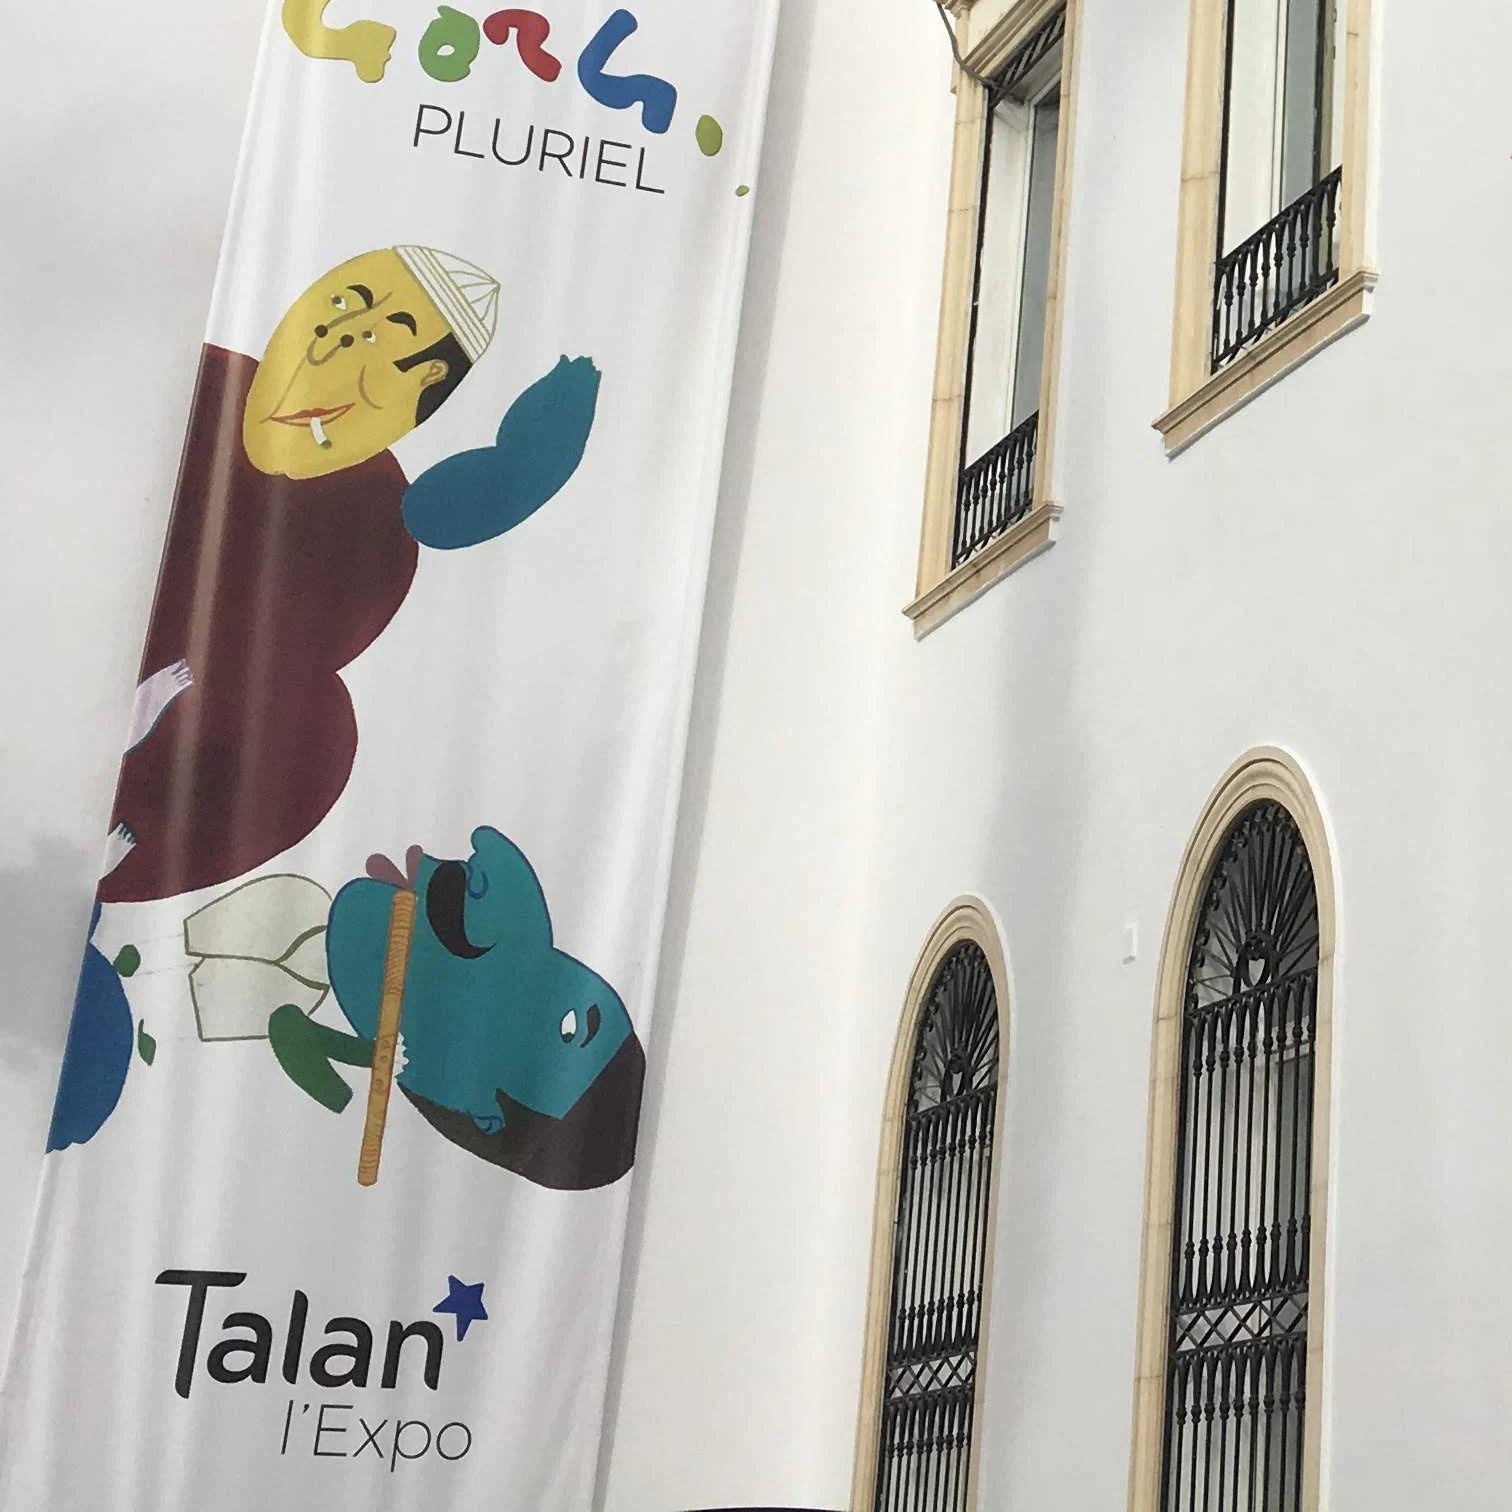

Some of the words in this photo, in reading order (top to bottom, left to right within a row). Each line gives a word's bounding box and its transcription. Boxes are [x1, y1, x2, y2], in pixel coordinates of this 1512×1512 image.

[413, 104, 665, 194] PLURIEL
[155, 1269, 444, 1399] Talan
[281, 1399, 472, 1473] l'Expo
